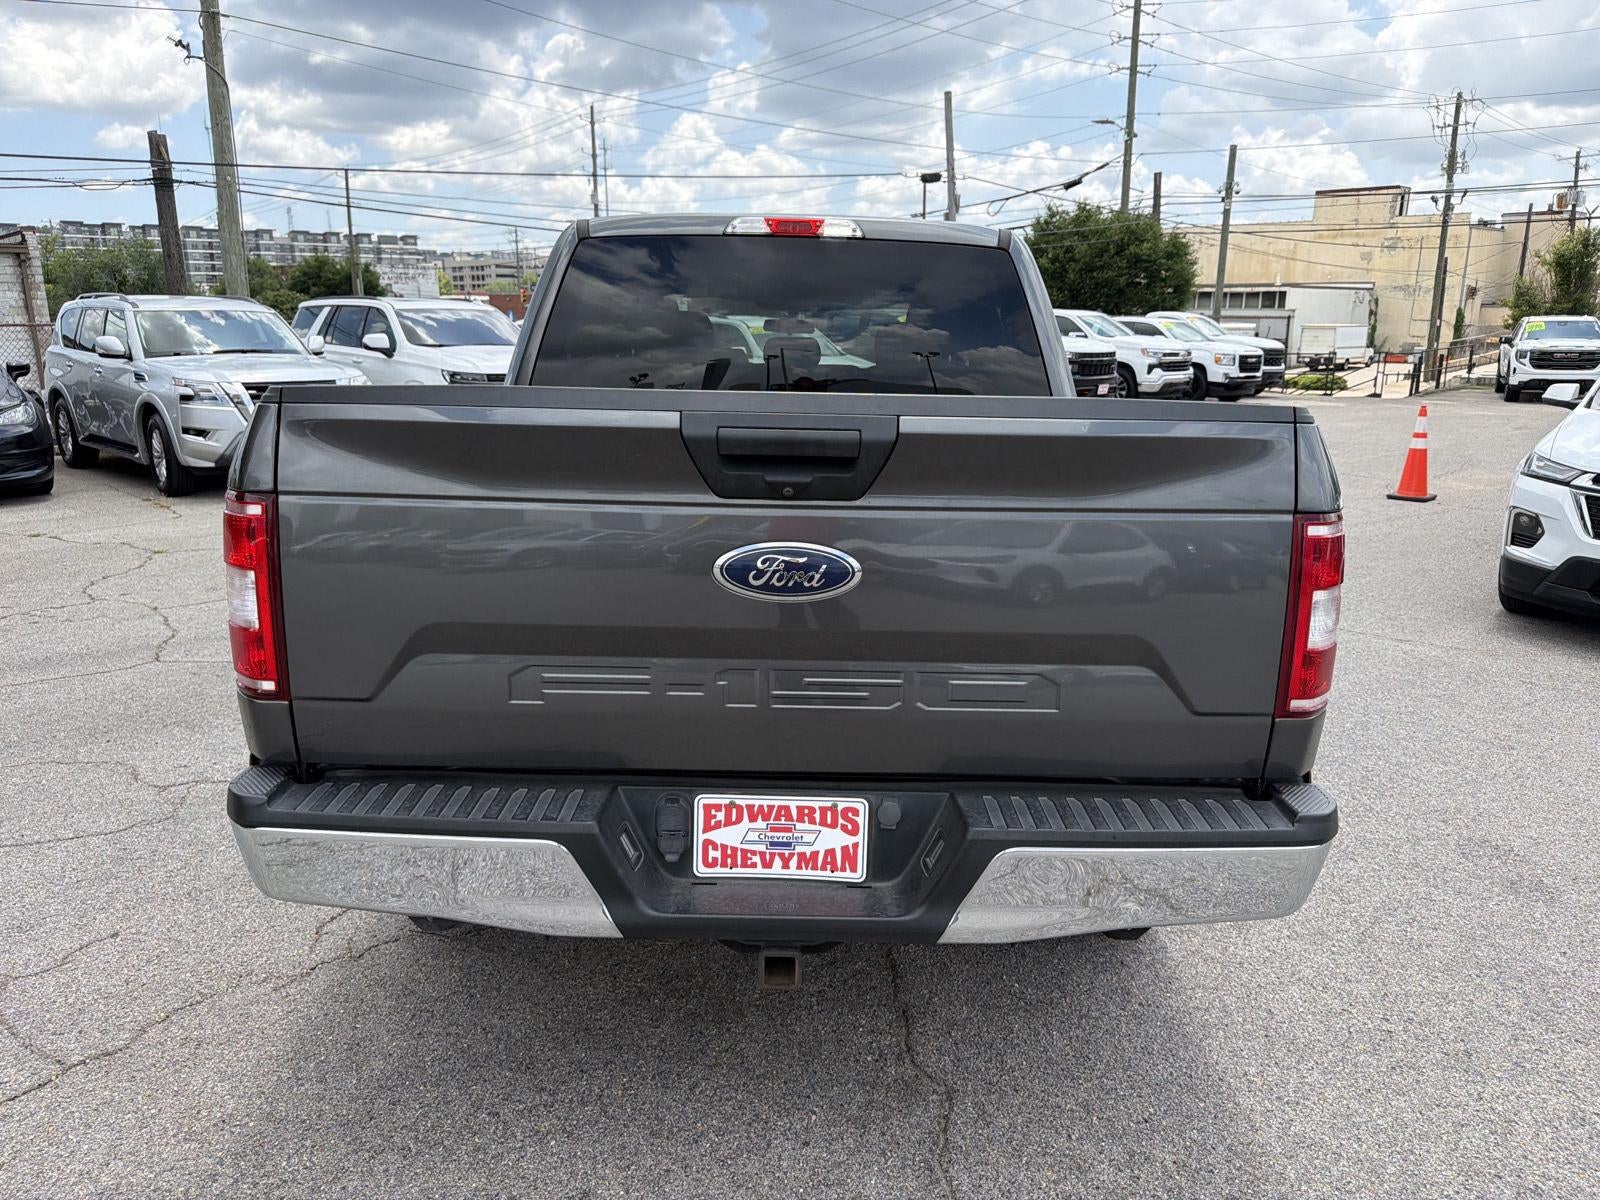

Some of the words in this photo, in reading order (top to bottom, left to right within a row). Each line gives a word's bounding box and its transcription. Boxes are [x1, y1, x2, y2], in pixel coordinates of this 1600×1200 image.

[1552, 352, 1580, 360] GMC
[748, 554, 828, 588] Ford
[508, 664, 1061, 713] F-150
[702, 803, 860, 837] EDWARDS
[757, 832, 804, 842] Chevrolet
[702, 838, 860, 874] CHEVYMAN
